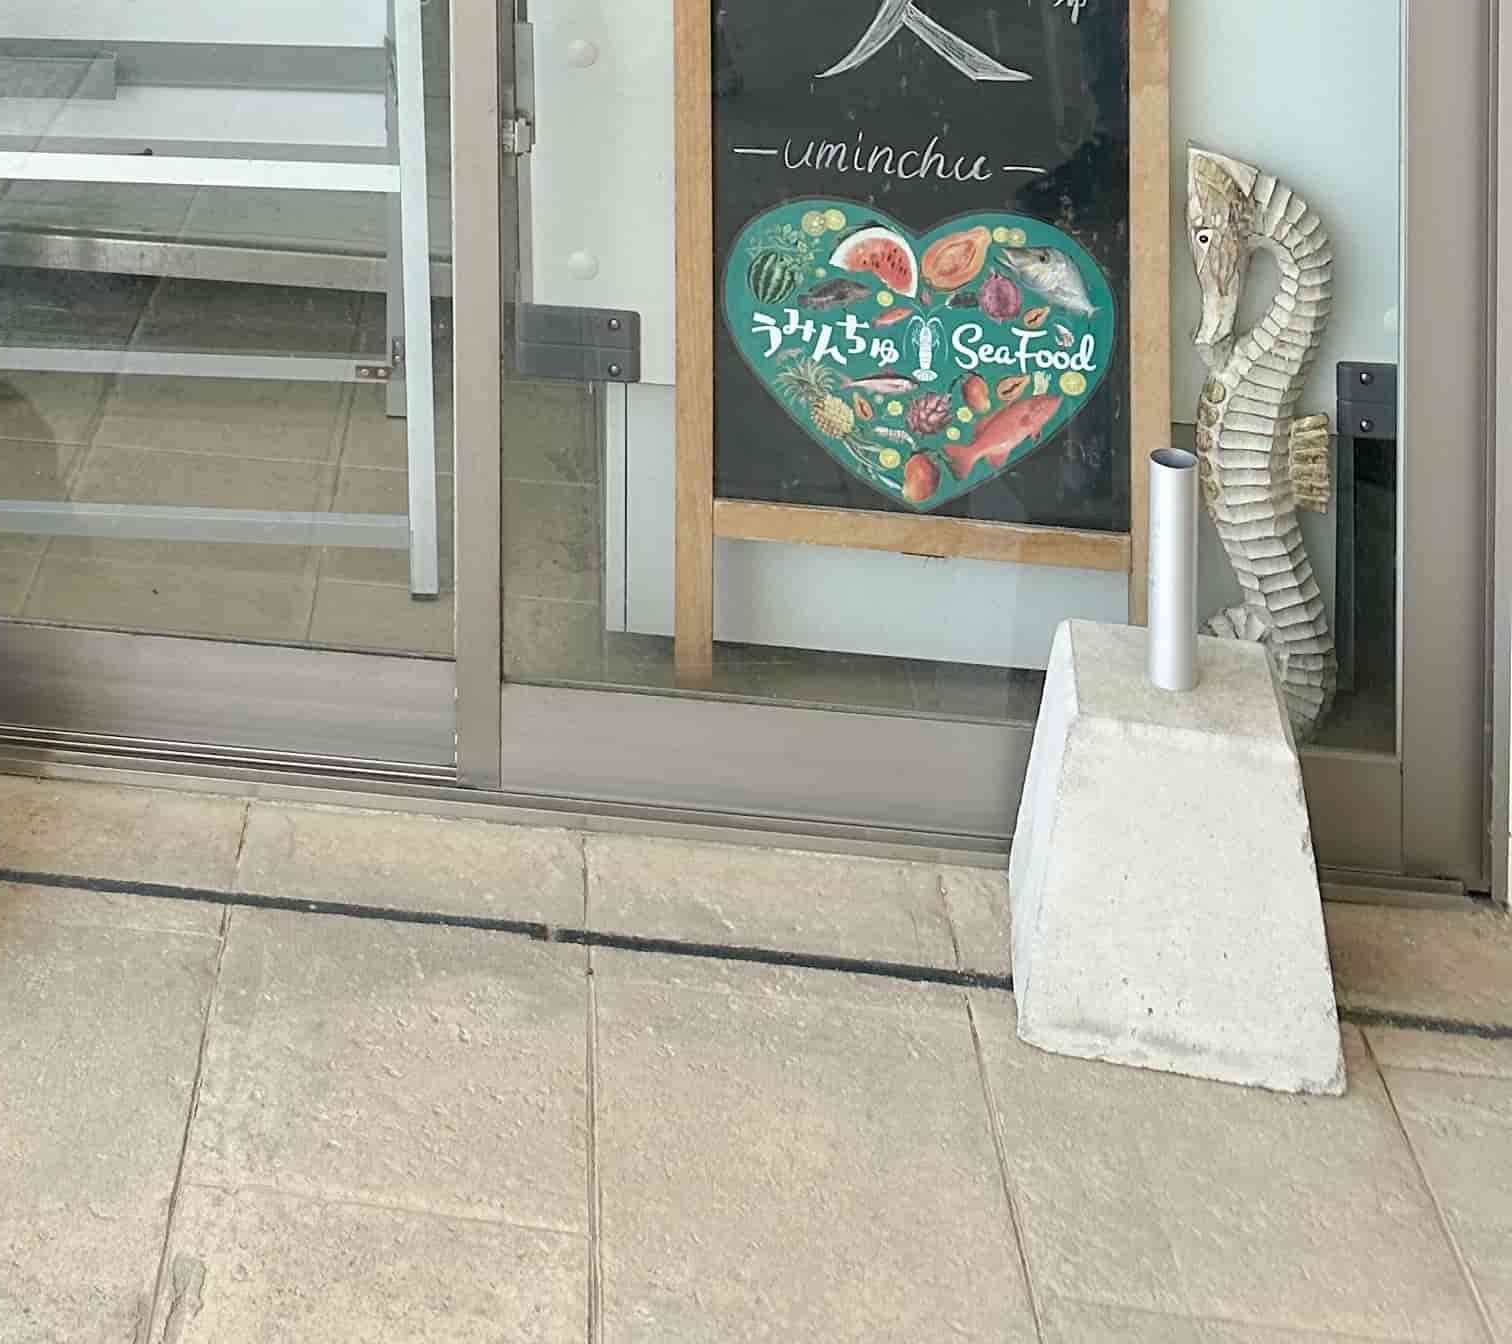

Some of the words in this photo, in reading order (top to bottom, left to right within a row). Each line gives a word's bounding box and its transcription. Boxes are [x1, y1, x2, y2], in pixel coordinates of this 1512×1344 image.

[751, 308, 900, 368] うみんちゅ
